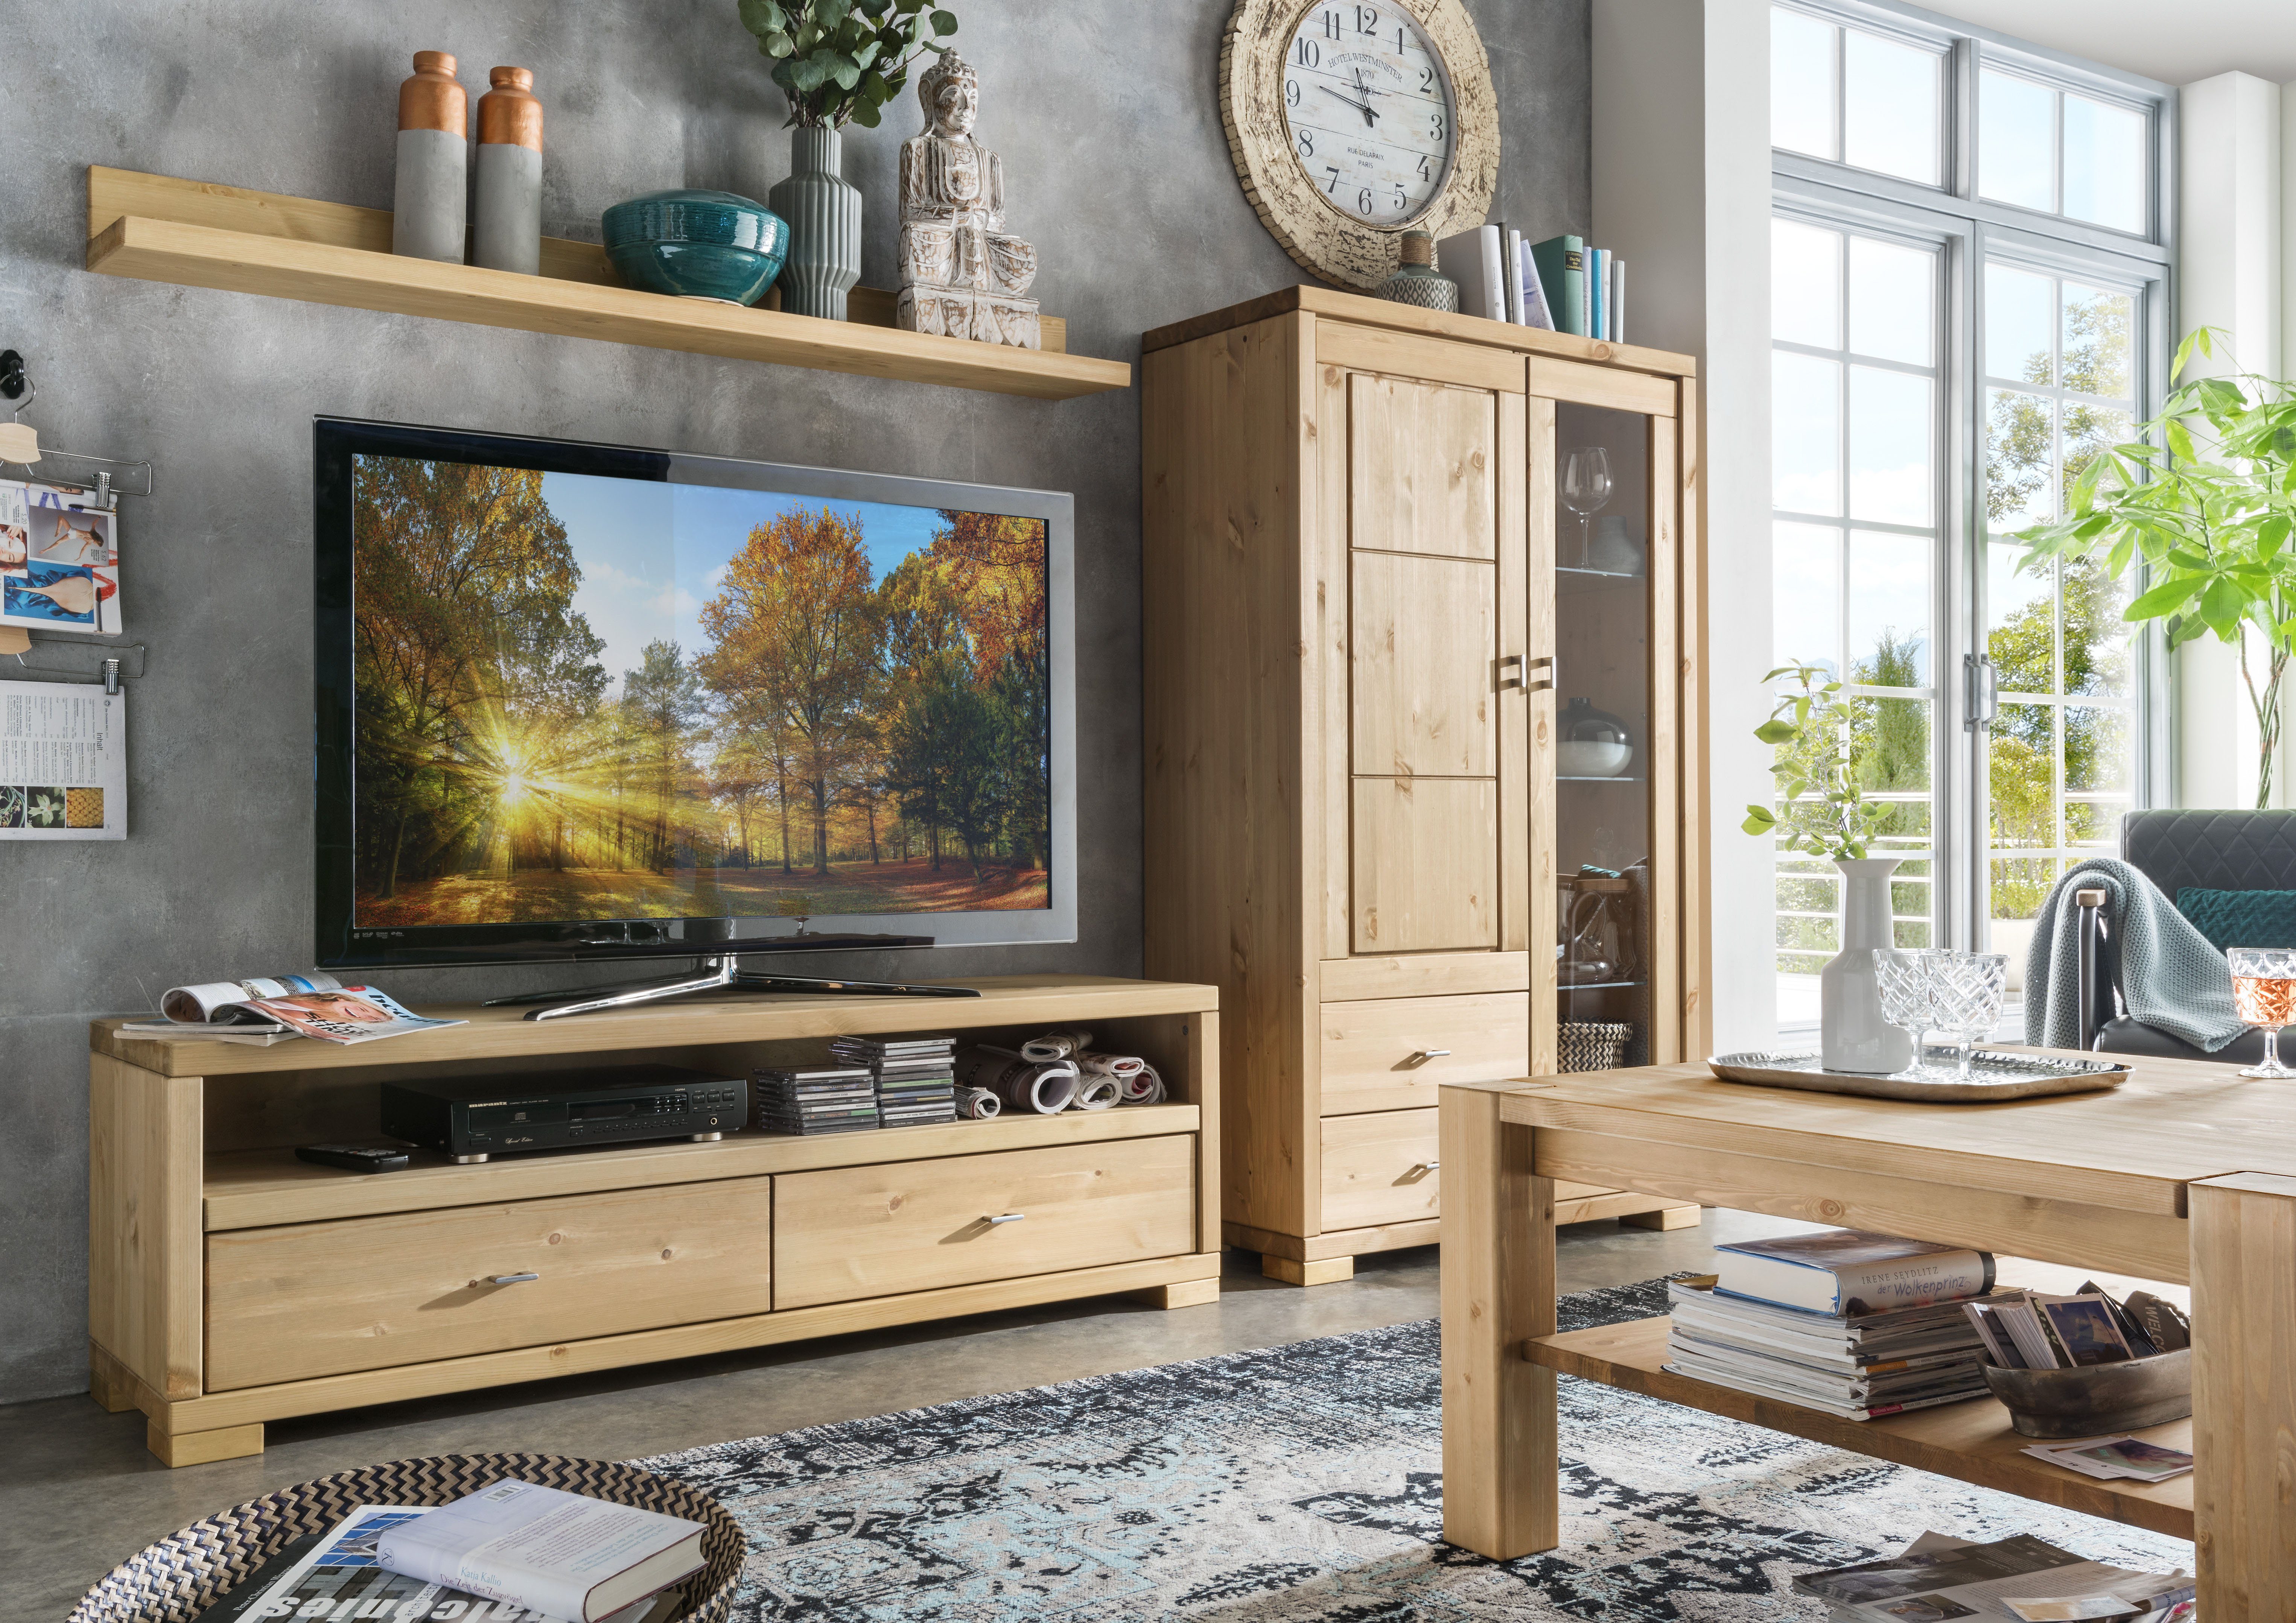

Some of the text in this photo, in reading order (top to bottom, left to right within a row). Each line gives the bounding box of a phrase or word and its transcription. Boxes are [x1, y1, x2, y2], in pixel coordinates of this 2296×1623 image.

[1322, 11, 1342, 41] 11
[1354, 5, 1378, 36] 12
[1296, 37, 1319, 68] 10
[1395, 28, 1404, 56] 1
[1328, 53, 1402, 83] HOTEL WESTMINSTER
[1361, 69, 1374, 79] 1870
[1420, 67, 1432, 94] 2
[1286, 80, 1300, 107] 9
[1430, 114, 1442, 141] 3
[1299, 129, 1313, 157] 8
[1358, 160, 1373, 169] PARIS
[1417, 156, 1430, 182] 4
[1326, 166, 1339, 193] 7
[1359, 188, 1372, 215] 6
[1394, 183, 1406, 210] 5
[1861, 1266, 1938, 1284] IRENE SEYDLITZ
[1878, 1274, 1970, 1298] der Wolkenprinz
[440, 1574, 523, 1604] Die Zeit der Zugvögel
[461, 1567, 502, 1587] Katja Kallio
[233, 1580, 272, 1611] Peter-Christian
